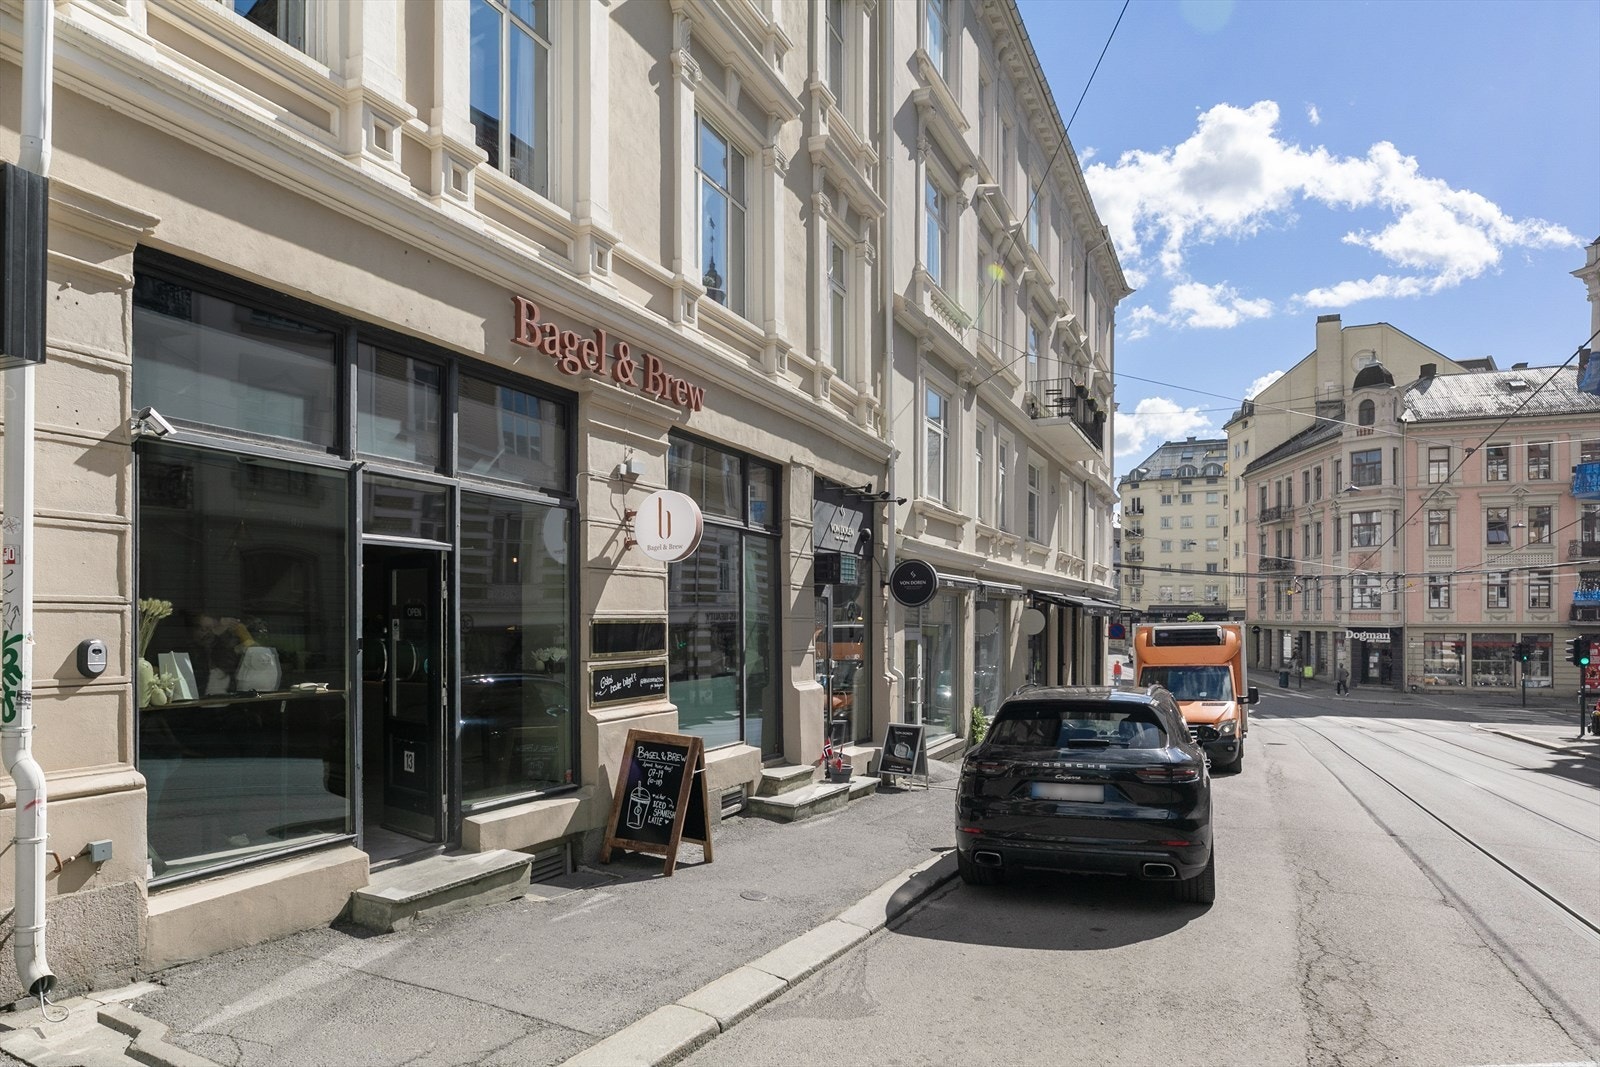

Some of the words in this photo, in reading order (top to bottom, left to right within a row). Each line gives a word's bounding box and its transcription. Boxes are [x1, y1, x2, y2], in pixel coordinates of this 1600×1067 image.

[511, 296, 607, 376] Bagel
[612, 341, 638, 387] &
[641, 353, 706, 412] Brew
[407, 607, 422, 617] OPEN
[1345, 630, 1391, 642] Dogman
[637, 746, 660, 760] BAGEL
[661, 751, 666, 760] &
[667, 751, 688, 762] BREW
[406, 753, 413, 770] 13
[653, 800, 667, 810] ICED
[653, 809, 676, 819] SPANISH
[648, 815, 663, 826] LATTE
